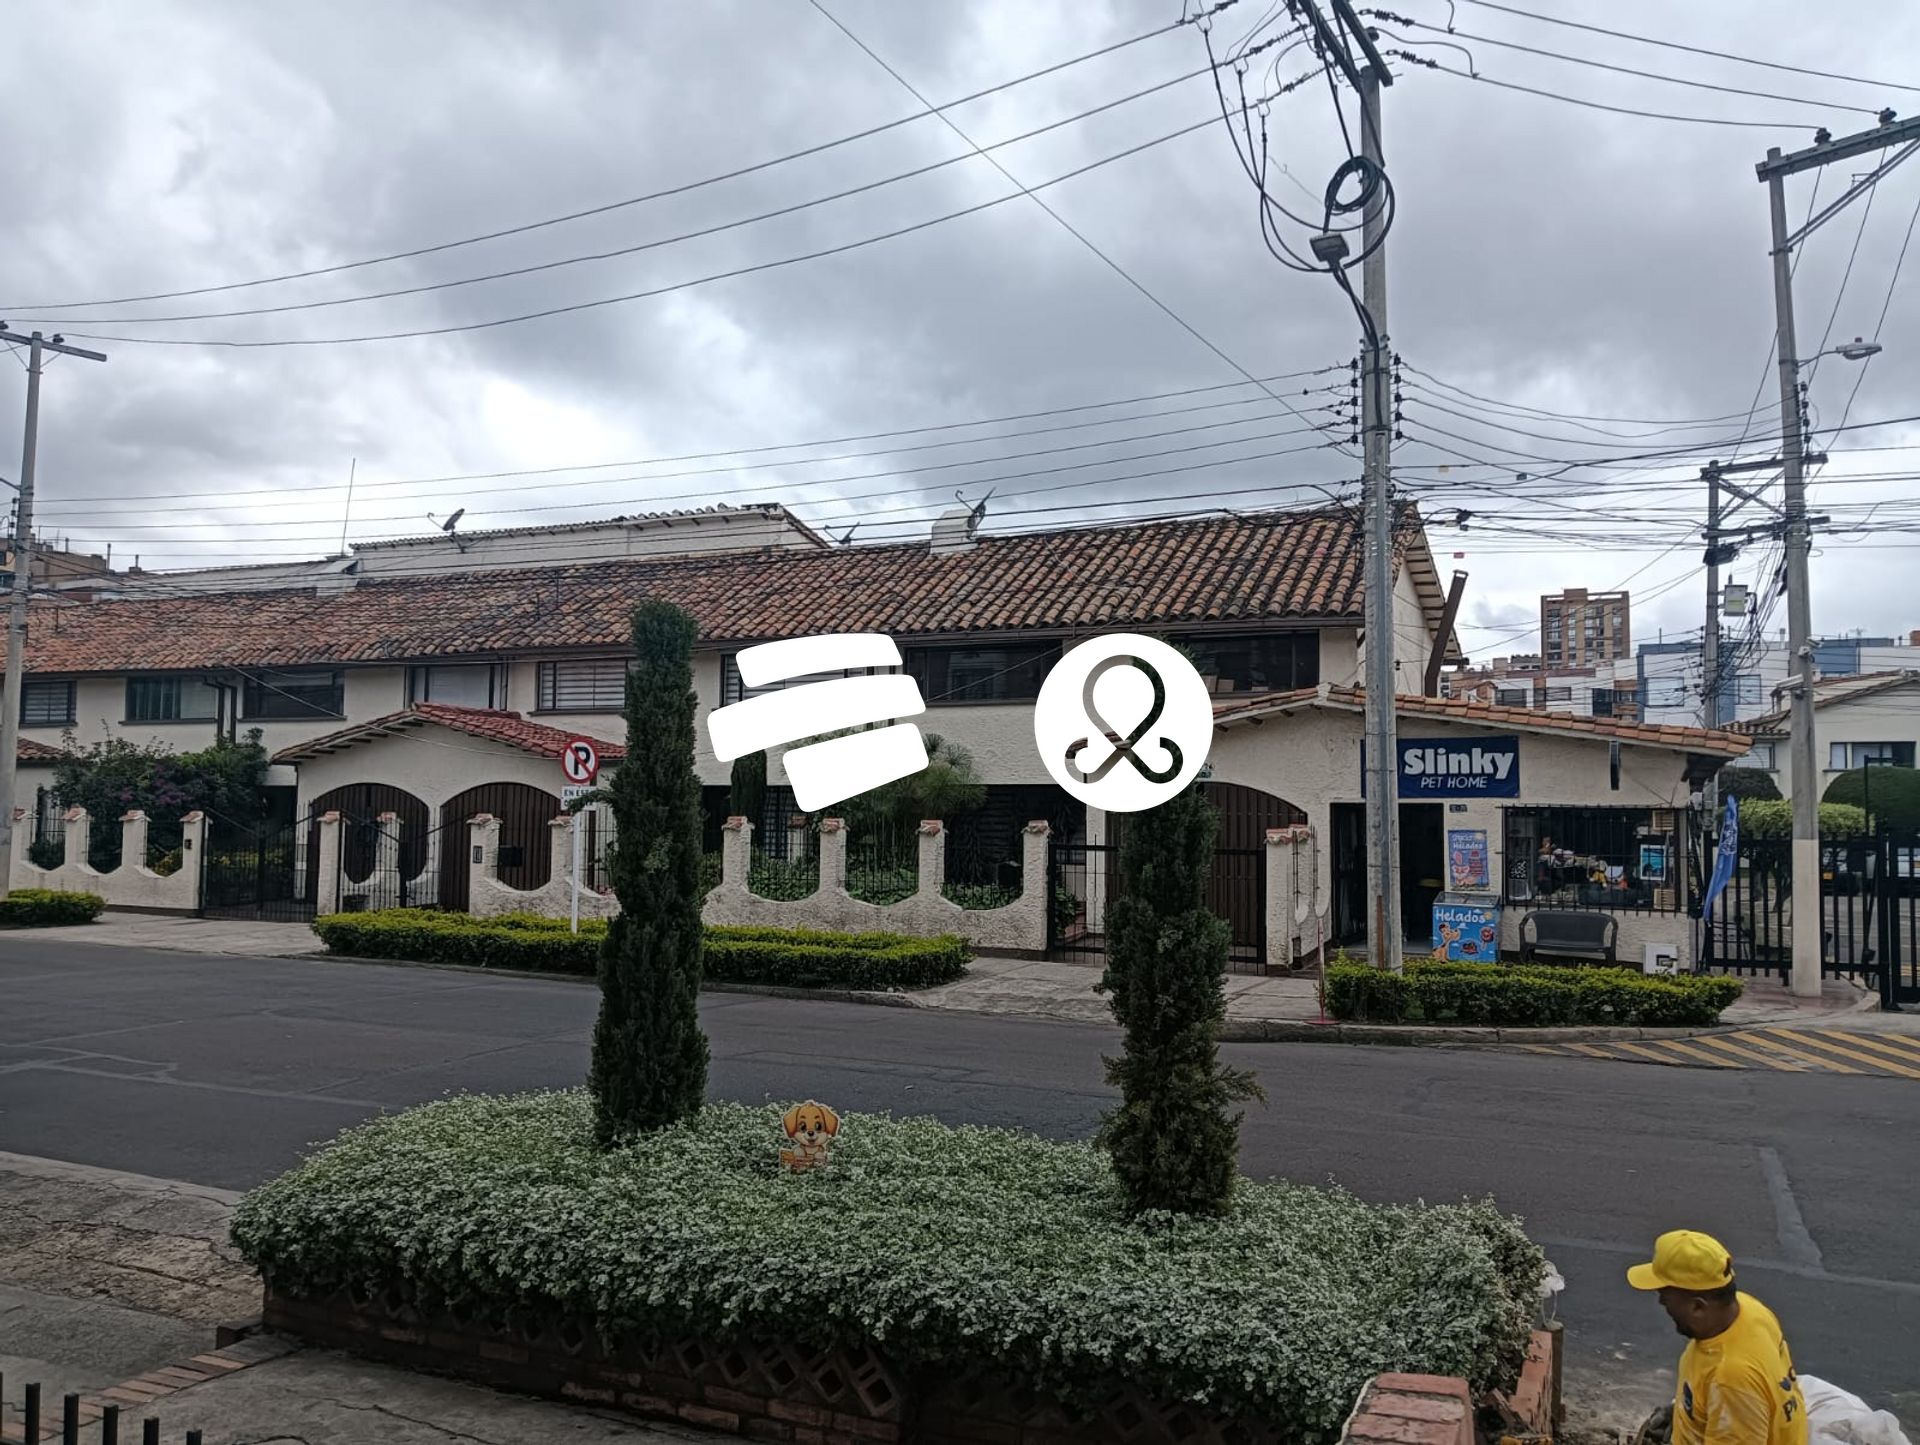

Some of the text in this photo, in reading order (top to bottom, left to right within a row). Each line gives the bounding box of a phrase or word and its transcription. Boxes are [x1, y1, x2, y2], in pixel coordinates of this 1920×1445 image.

[574, 746, 591, 775] P
[1404, 748, 1515, 780] Slinky
[1420, 777, 1488, 788] PET HOME
[1436, 908, 1486, 923] Helados
